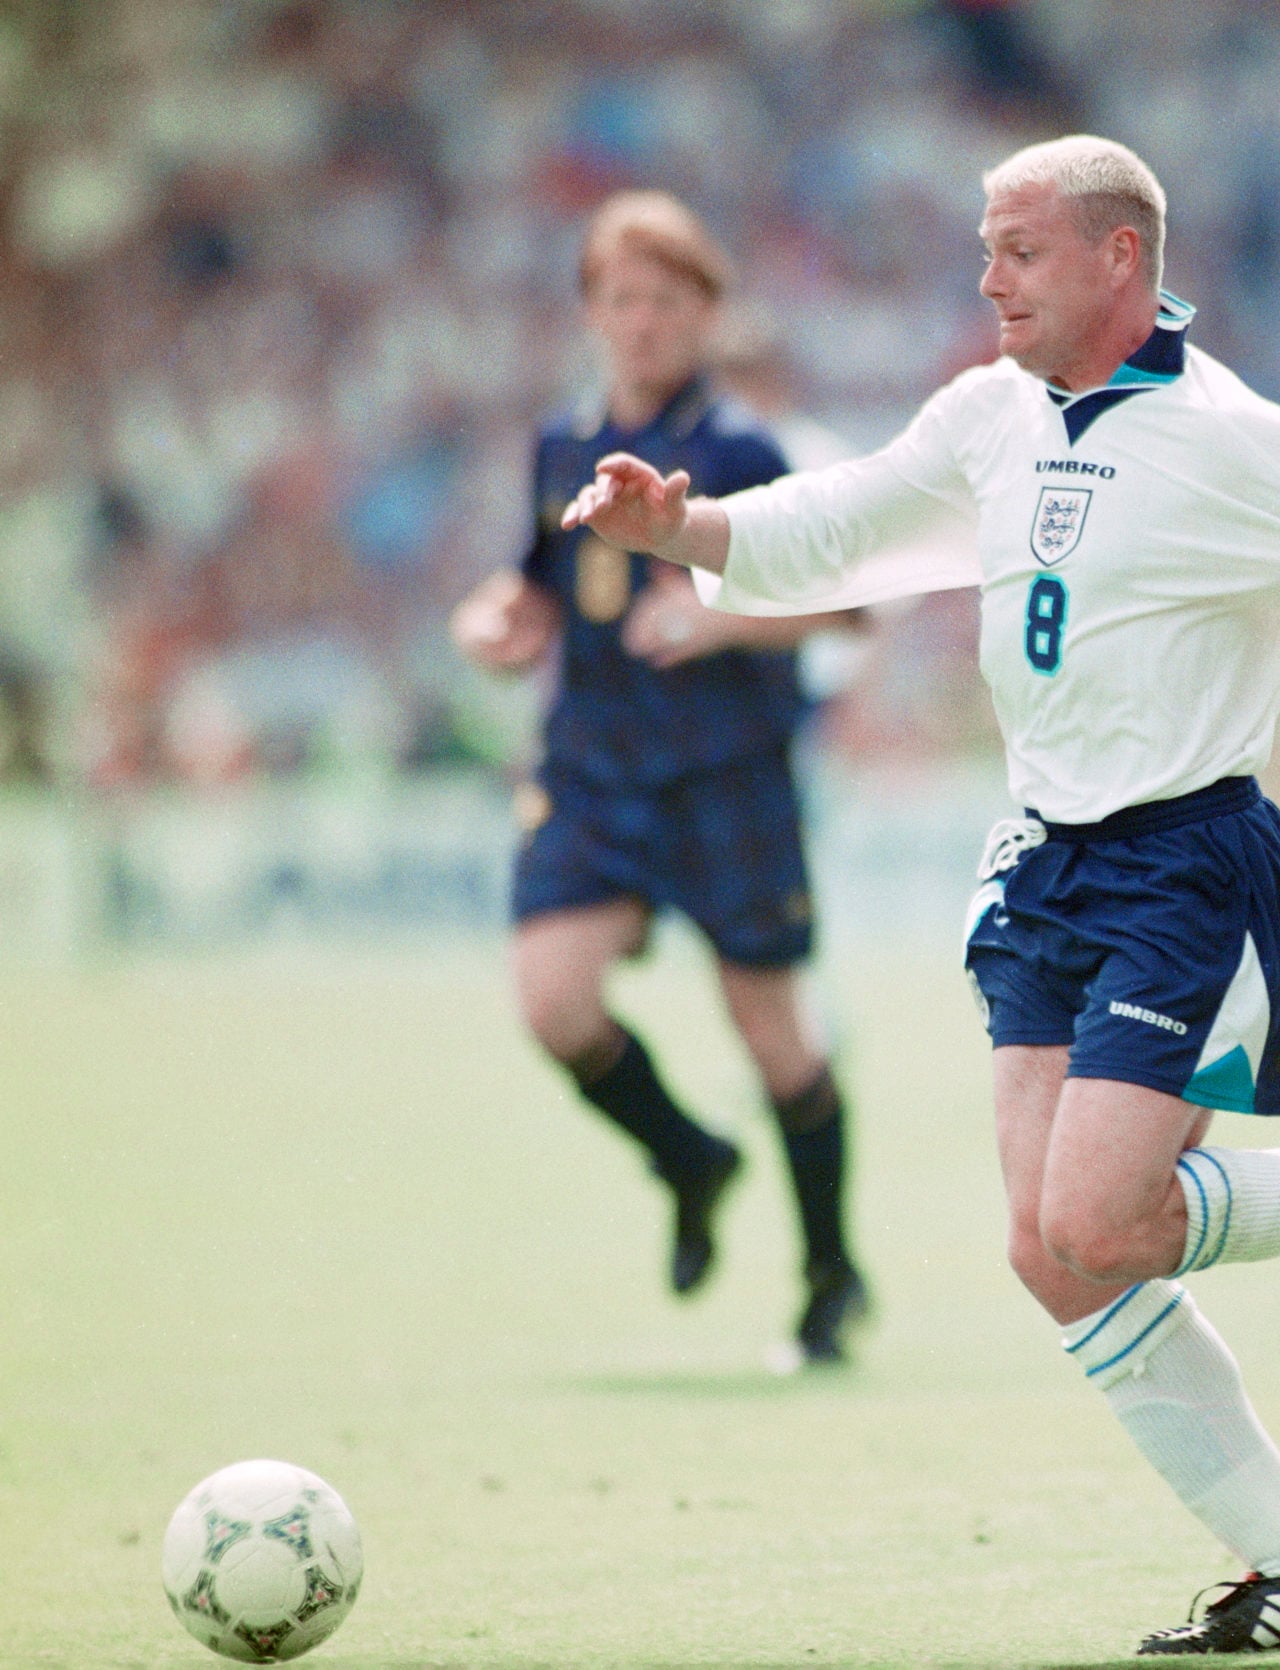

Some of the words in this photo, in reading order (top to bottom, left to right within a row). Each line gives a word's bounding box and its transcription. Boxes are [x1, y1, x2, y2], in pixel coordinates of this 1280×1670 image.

[1035, 460, 1116, 480] UMBRO
[1024, 571, 1069, 678] 8
[1109, 1000, 1188, 1035] UMBRO
